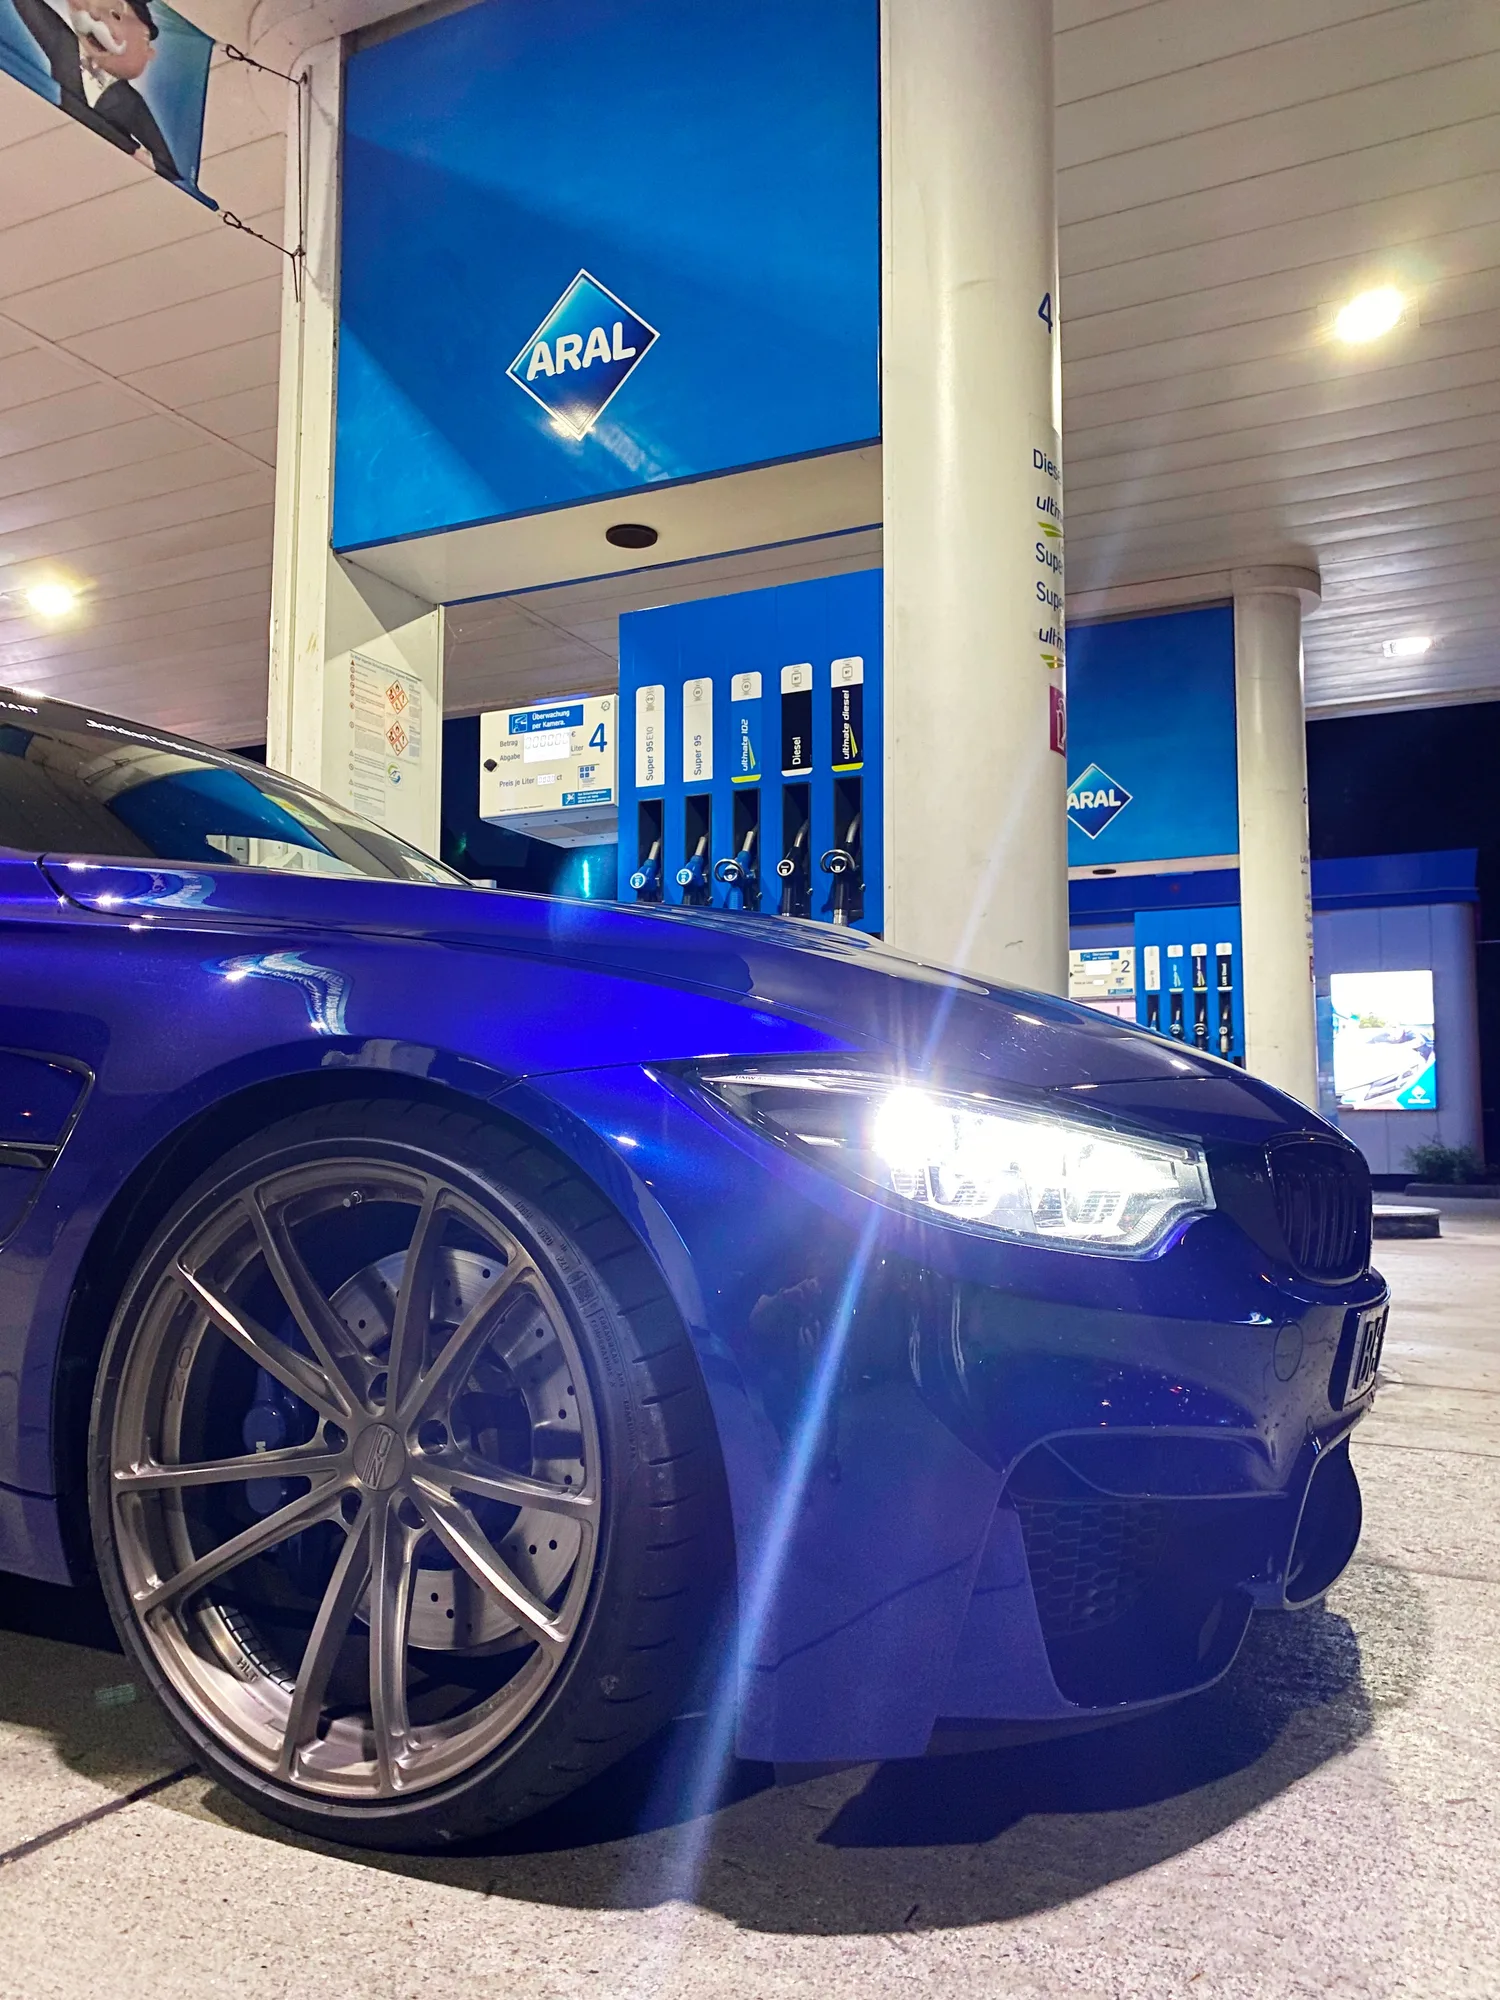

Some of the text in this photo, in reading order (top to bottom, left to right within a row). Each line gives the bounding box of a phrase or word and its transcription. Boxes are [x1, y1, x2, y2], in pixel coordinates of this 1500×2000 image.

[1037, 292, 1053, 334] 4
[526, 321, 636, 382] ARAL
[532, 710, 570, 721] Überwachung
[532, 719, 565, 730] per Kamera.
[842, 690, 850, 759] ultimate diesel
[499, 739, 518, 748] Betrag
[588, 722, 608, 753] 4
[499, 744, 584, 762] Abgabe Liter
[694, 734, 703, 775] Super 95
[792, 737, 801, 765] Diesel
[646, 755, 655, 781] Super
[499, 779, 514, 788] Preis
[514, 779, 521, 787] je
[521, 777, 535, 785] Liter
[1066, 788, 1121, 811] ARAL
[1121, 959, 1131, 973] 2
